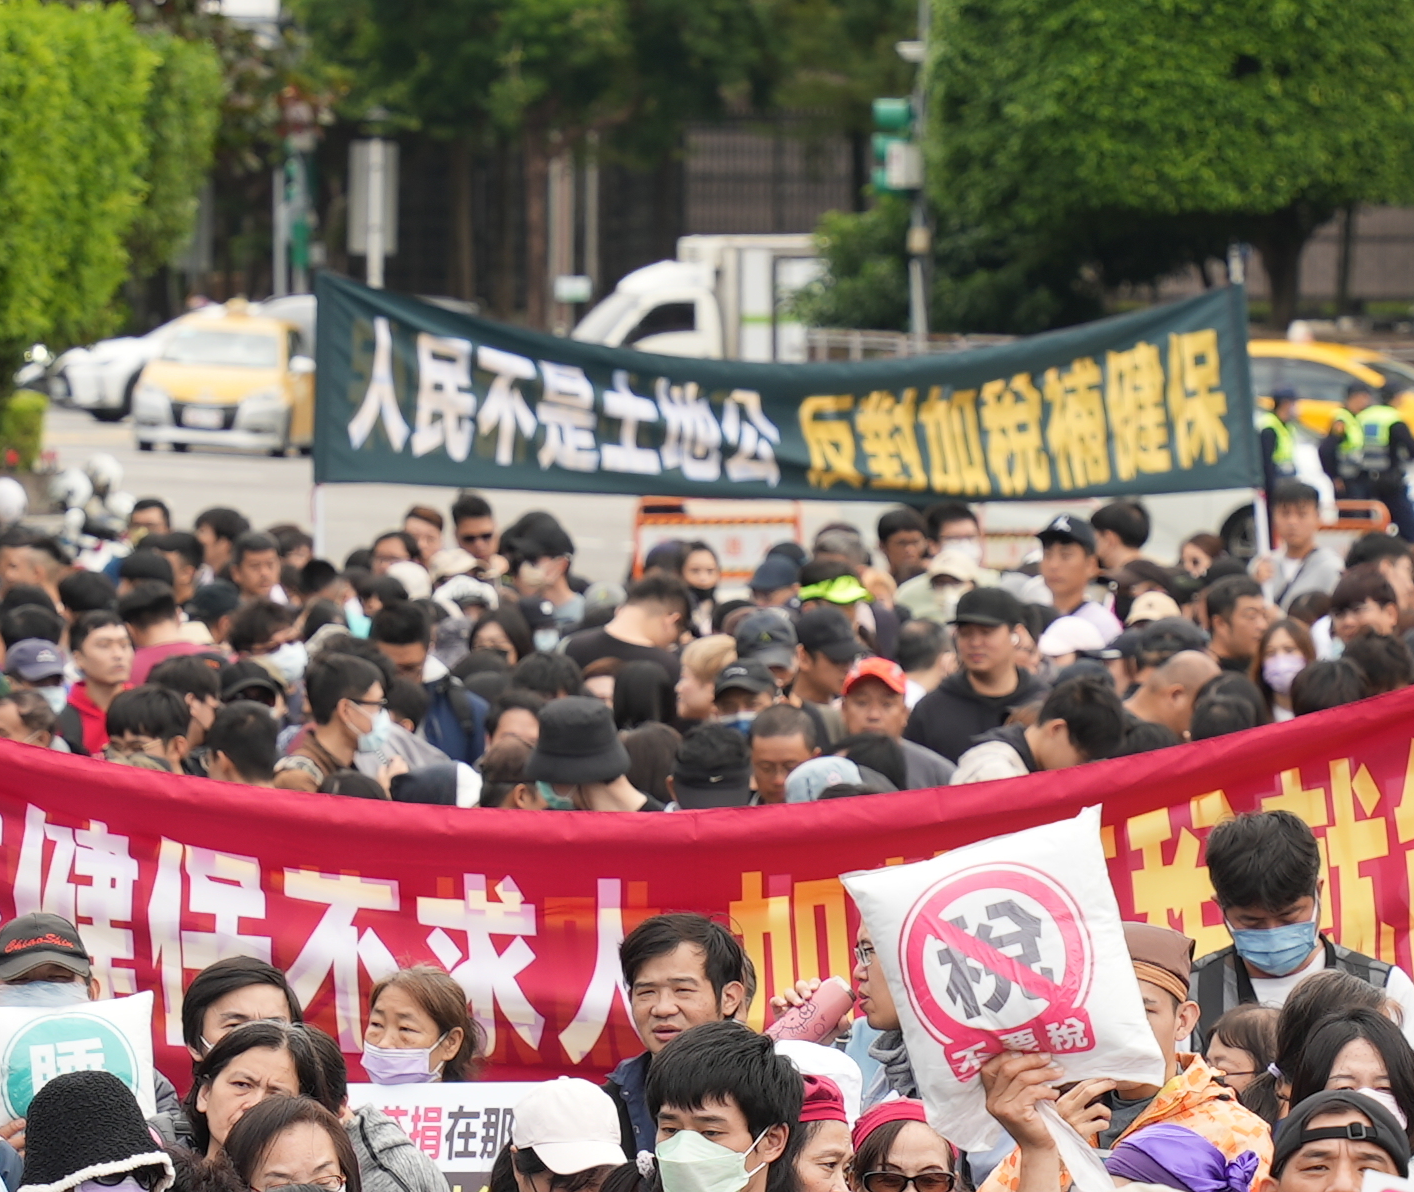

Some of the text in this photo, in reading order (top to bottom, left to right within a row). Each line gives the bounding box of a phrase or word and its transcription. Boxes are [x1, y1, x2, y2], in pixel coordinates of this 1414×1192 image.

[346, 315, 1229, 500] 人民不是土地公 反對加稅補健保
[938, 899, 1053, 1020] 稅
[952, 1020, 1088, 1082] 不要稅
